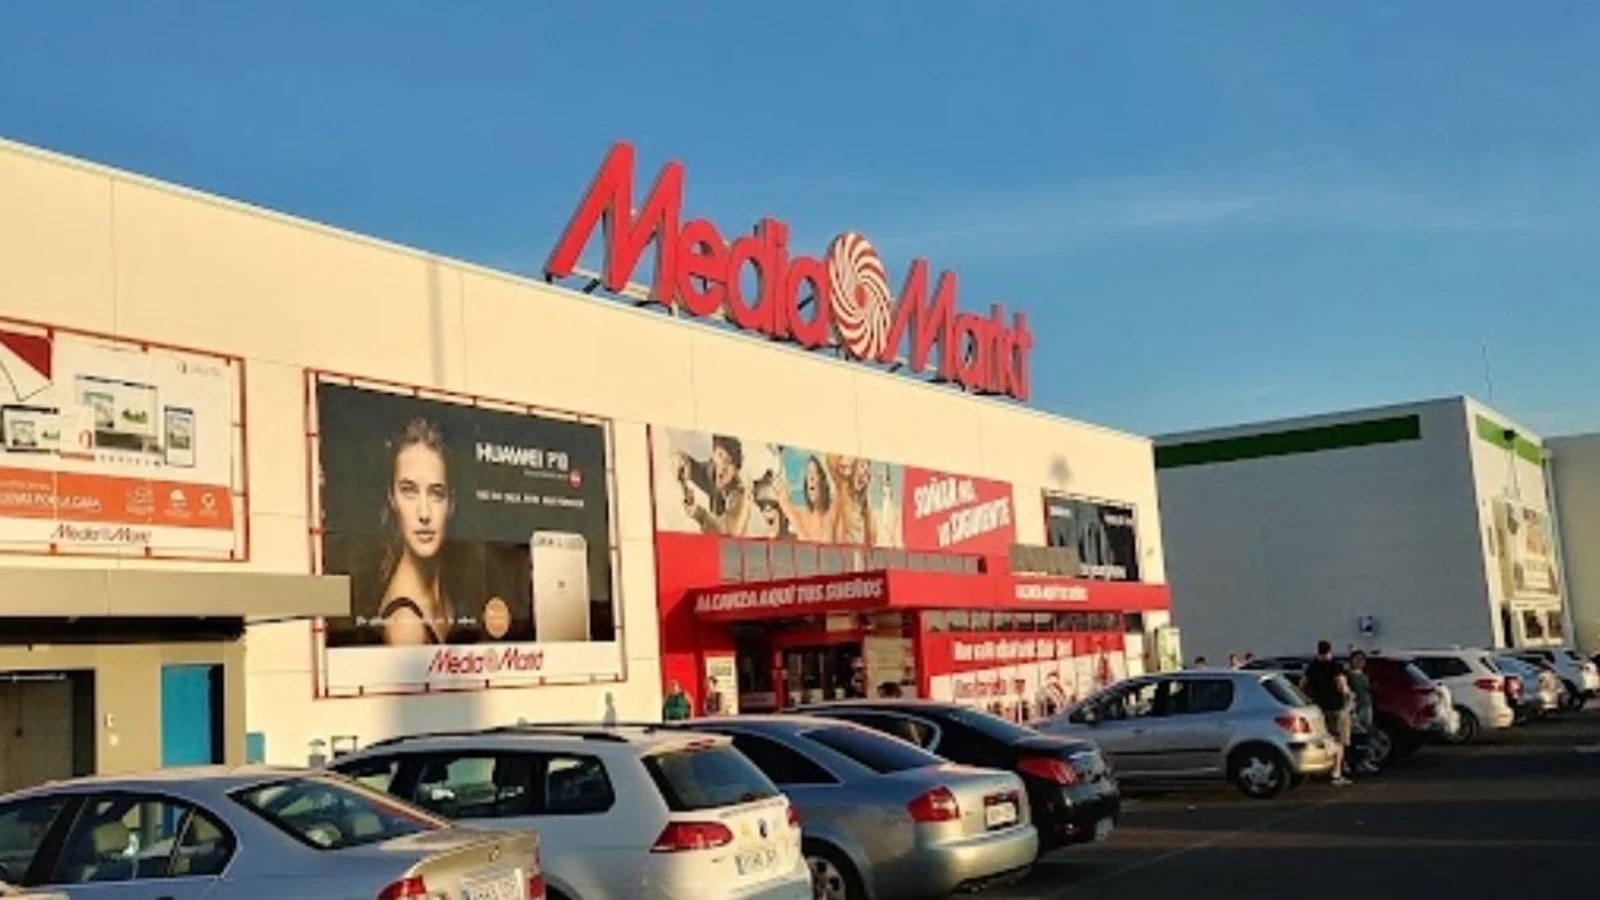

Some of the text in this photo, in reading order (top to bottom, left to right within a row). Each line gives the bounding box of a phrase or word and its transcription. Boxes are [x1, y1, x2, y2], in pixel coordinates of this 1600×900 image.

[545, 141, 1033, 401] Media Markt
[476, 442, 543, 468] HUAWEI
[427, 647, 544, 675] Media Markt
